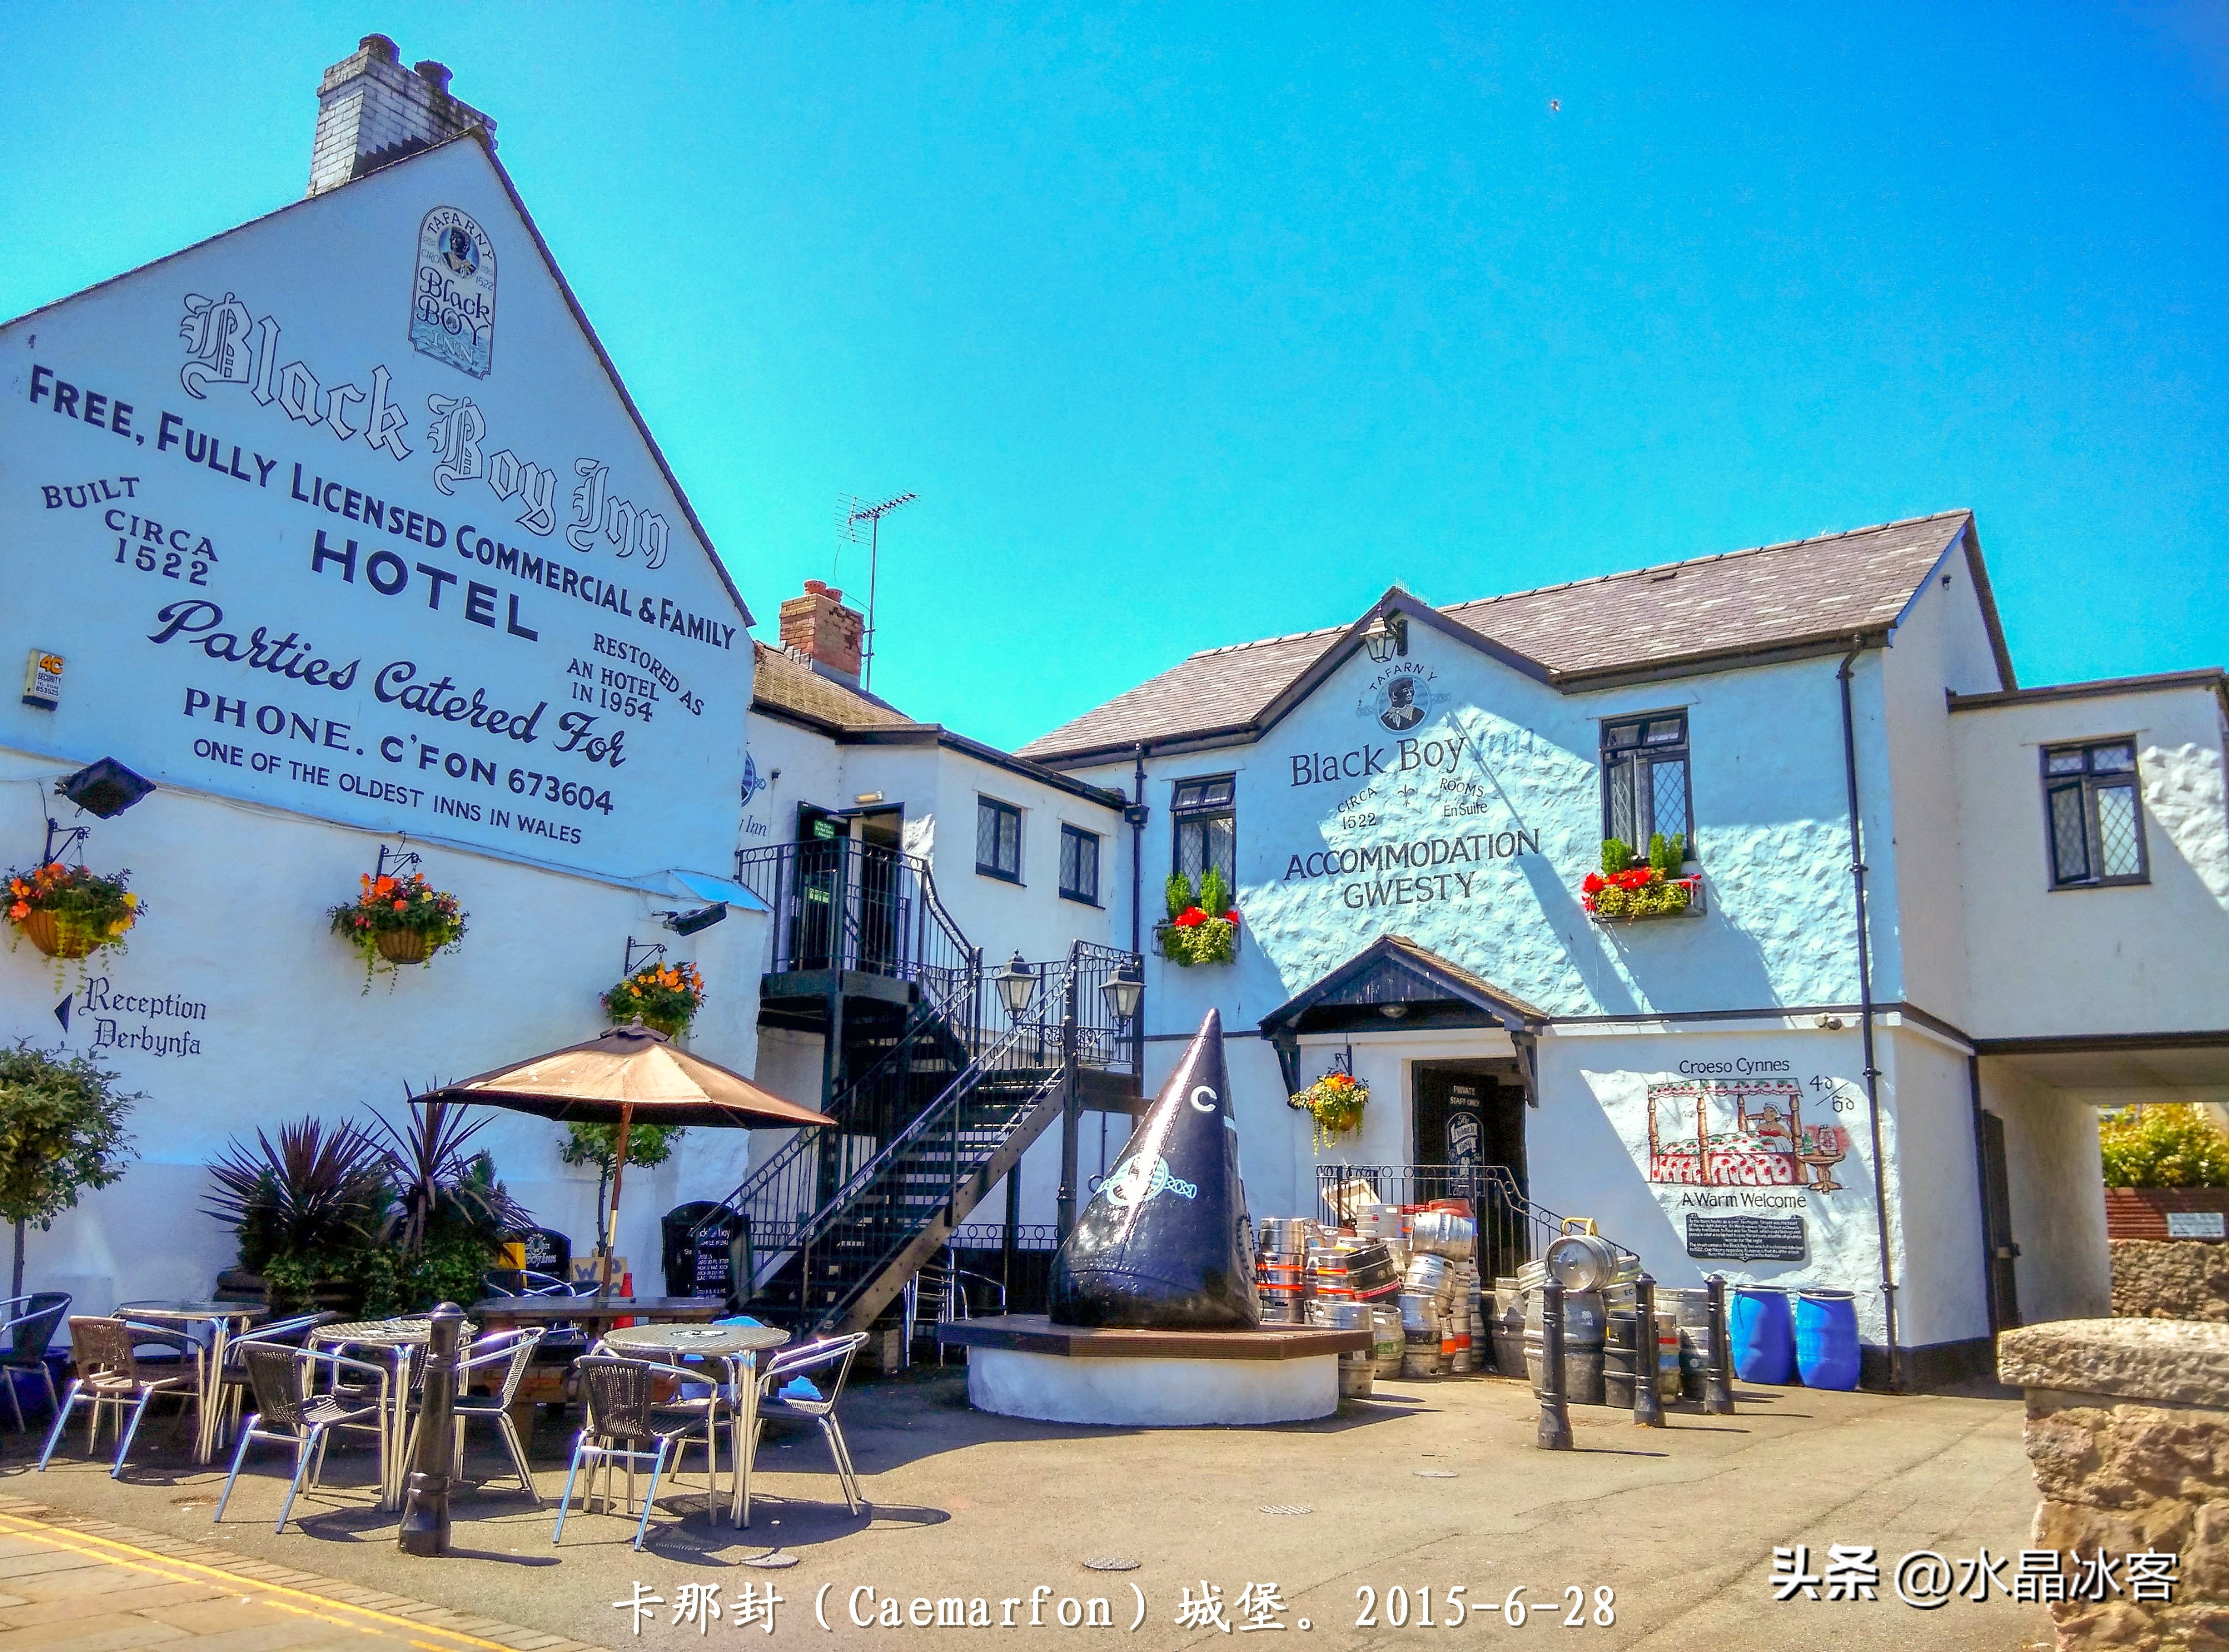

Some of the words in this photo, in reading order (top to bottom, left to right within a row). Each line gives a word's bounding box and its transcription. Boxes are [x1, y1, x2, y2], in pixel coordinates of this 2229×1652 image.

[427, 212, 487, 246] TAFARN
[482, 251, 493, 260] Y
[421, 248, 443, 266] CIRCA
[420, 266, 492, 326] Black
[475, 276, 494, 290] 1522
[432, 330, 475, 365] INN
[179, 292, 414, 461] Black
[427, 394, 558, 536] Boy
[566, 458, 670, 569] Inn
[30, 364, 145, 446] FREE,
[157, 411, 277, 487] FULLY
[290, 462, 448, 548] LICENSED
[455, 525, 633, 617] COMMERCIAL
[41, 476, 140, 510] BUILT
[104, 508, 219, 563] CIRCA
[114, 537, 209, 586] 1522
[311, 529, 538, 643] HOTEL
[37, 672, 62, 684] SECURITY
[40, 655, 63, 675] 4C
[146, 599, 362, 691] Parties
[373, 660, 548, 744] Catered
[553, 711, 627, 768] For
[567, 658, 593, 680] AN
[600, 667, 661, 702] HOTEL
[593, 632, 681, 694] RESTORED
[679, 689, 705, 716] AS
[1369, 661, 1425, 692] TAFARN
[1428, 670, 1438, 683] Y
[36, 685, 59, 696] 853525
[572, 682, 592, 704] IN
[599, 685, 653, 723] 1954
[183, 687, 365, 756] PHONE.
[380, 733, 498, 787] C'FON
[507, 768, 615, 816] 673604
[1289, 744, 1388, 787] Black
[1397, 737, 1467, 774] Boy
[193, 737, 243, 768] ONE
[251, 752, 282, 775] OF
[288, 759, 330, 787] THE
[337, 772, 425, 809] OLDEST
[433, 794, 482, 823] INNS
[489, 807, 510, 829] IN
[516, 814, 582, 845] WALES
[1337, 787, 1378, 813] CIRCA
[1440, 778, 1484, 797] ROOMS
[745, 814, 767, 836] Inn
[1342, 812, 1377, 830] 1522
[1283, 827, 1540, 881] ACCOMMODATION
[1343, 871, 1476, 909] GWESTY
[78, 976, 207, 1020] Reception
[90, 1016, 202, 1058] Derbynfa
[1679, 1059, 1733, 1075] Croeso
[1736, 1057, 1790, 1075] Cynnes
[1450, 1097, 1467, 1105] STAFF
[1454, 1085, 1476, 1096] PRIVATE
[1682, 1192, 1695, 1207] A
[1694, 1192, 1738, 1207] Warm
[1740, 1192, 1807, 1208] Welcome
